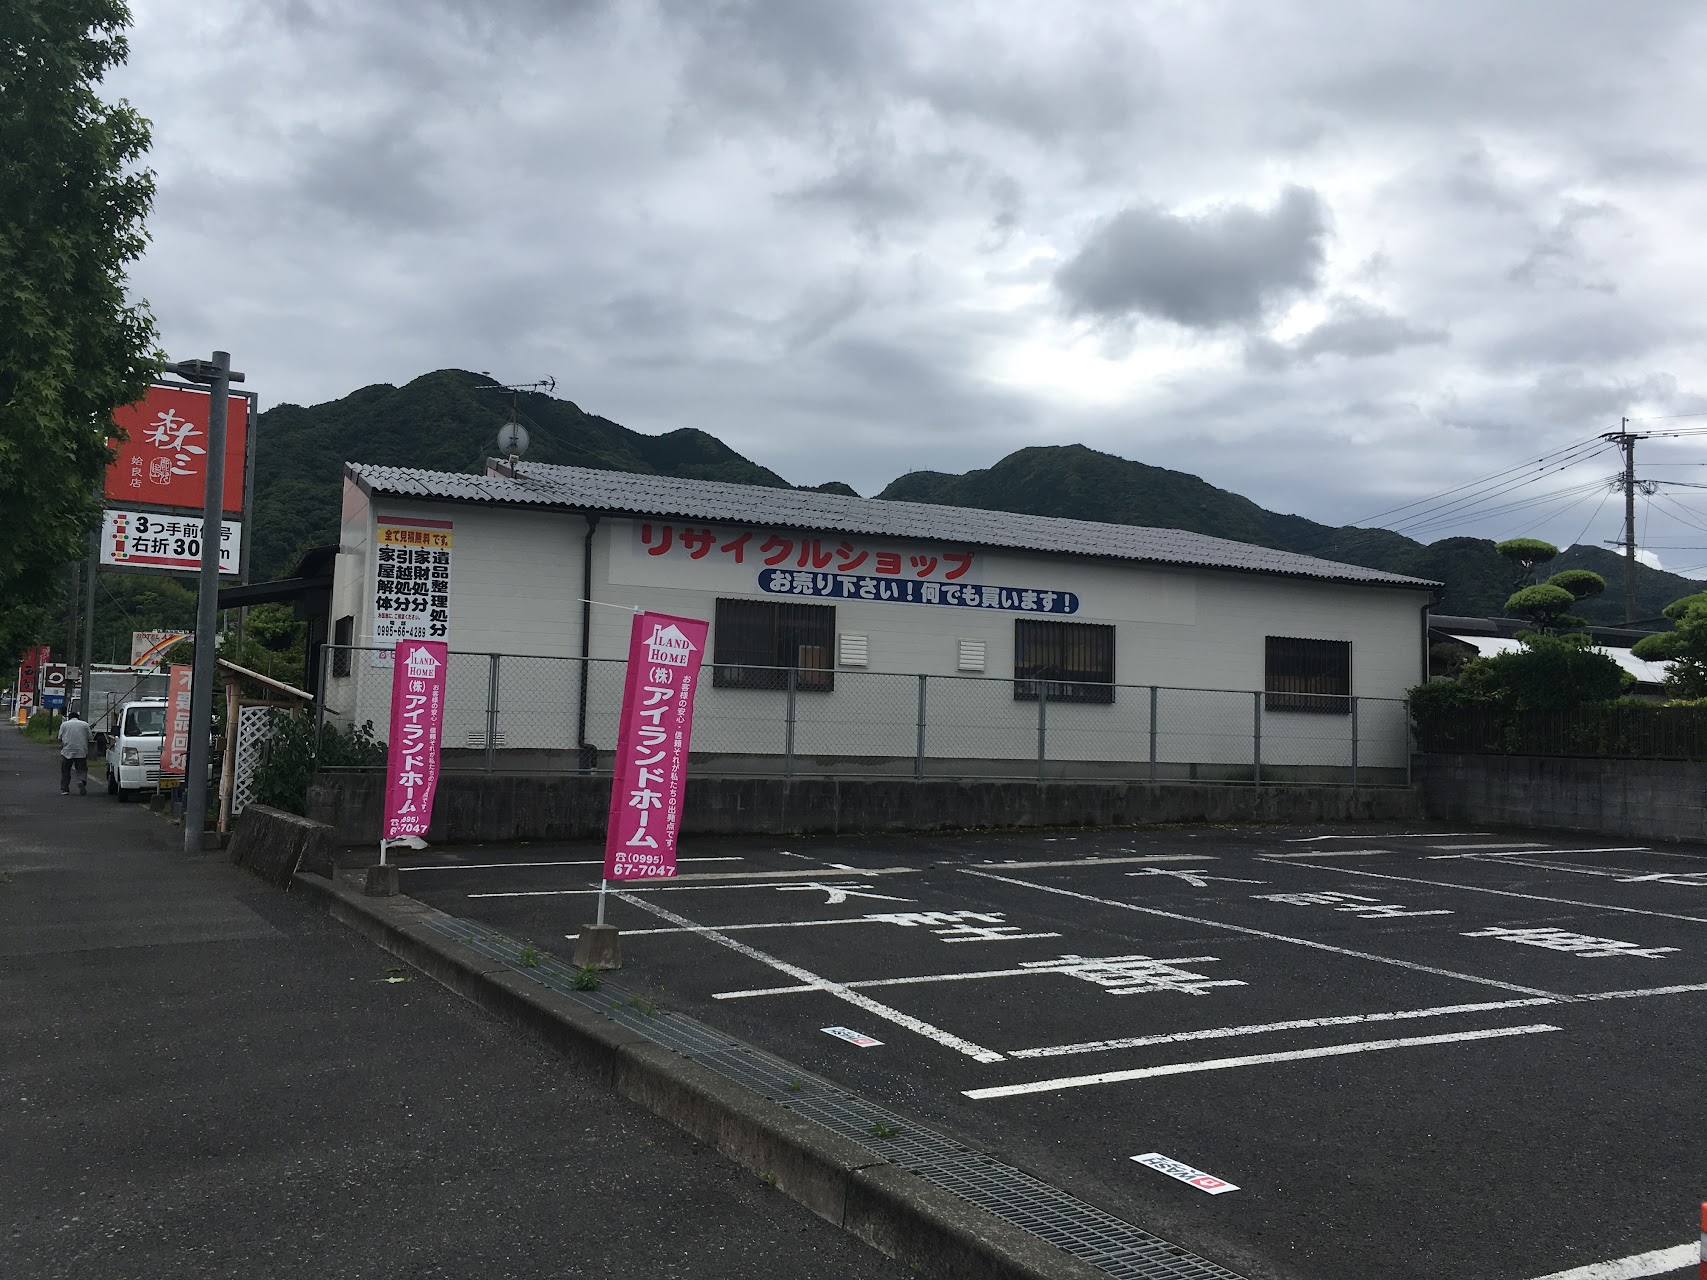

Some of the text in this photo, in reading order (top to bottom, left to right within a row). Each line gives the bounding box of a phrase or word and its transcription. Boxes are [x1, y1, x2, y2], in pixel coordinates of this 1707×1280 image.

[129, 456, 144, 488] 姶良店
[135, 516, 233, 541] 3つ手前号
[132, 536, 230, 560] 右折 30m
[640, 523, 975, 581] リサイクルショップ
[376, 547, 396, 611] 家屋解体
[393, 549, 413, 612] 引越処分
[411, 549, 431, 613] 家財処分
[429, 551, 450, 637] 遺品整理処分
[769, 571, 1072, 614] お売り下さい！何でも買います！
[377, 625, 426, 638] 0995-66-4289
[653, 628, 690, 650] ILAND
[411, 652, 435, 666] ILAND
[651, 648, 687, 664] HOME
[410, 665, 434, 677] HOME
[390, 823, 428, 835] 6-7047
[613, 863, 676, 877] 67-7047
[628, 853, 664, 864] (0995)
